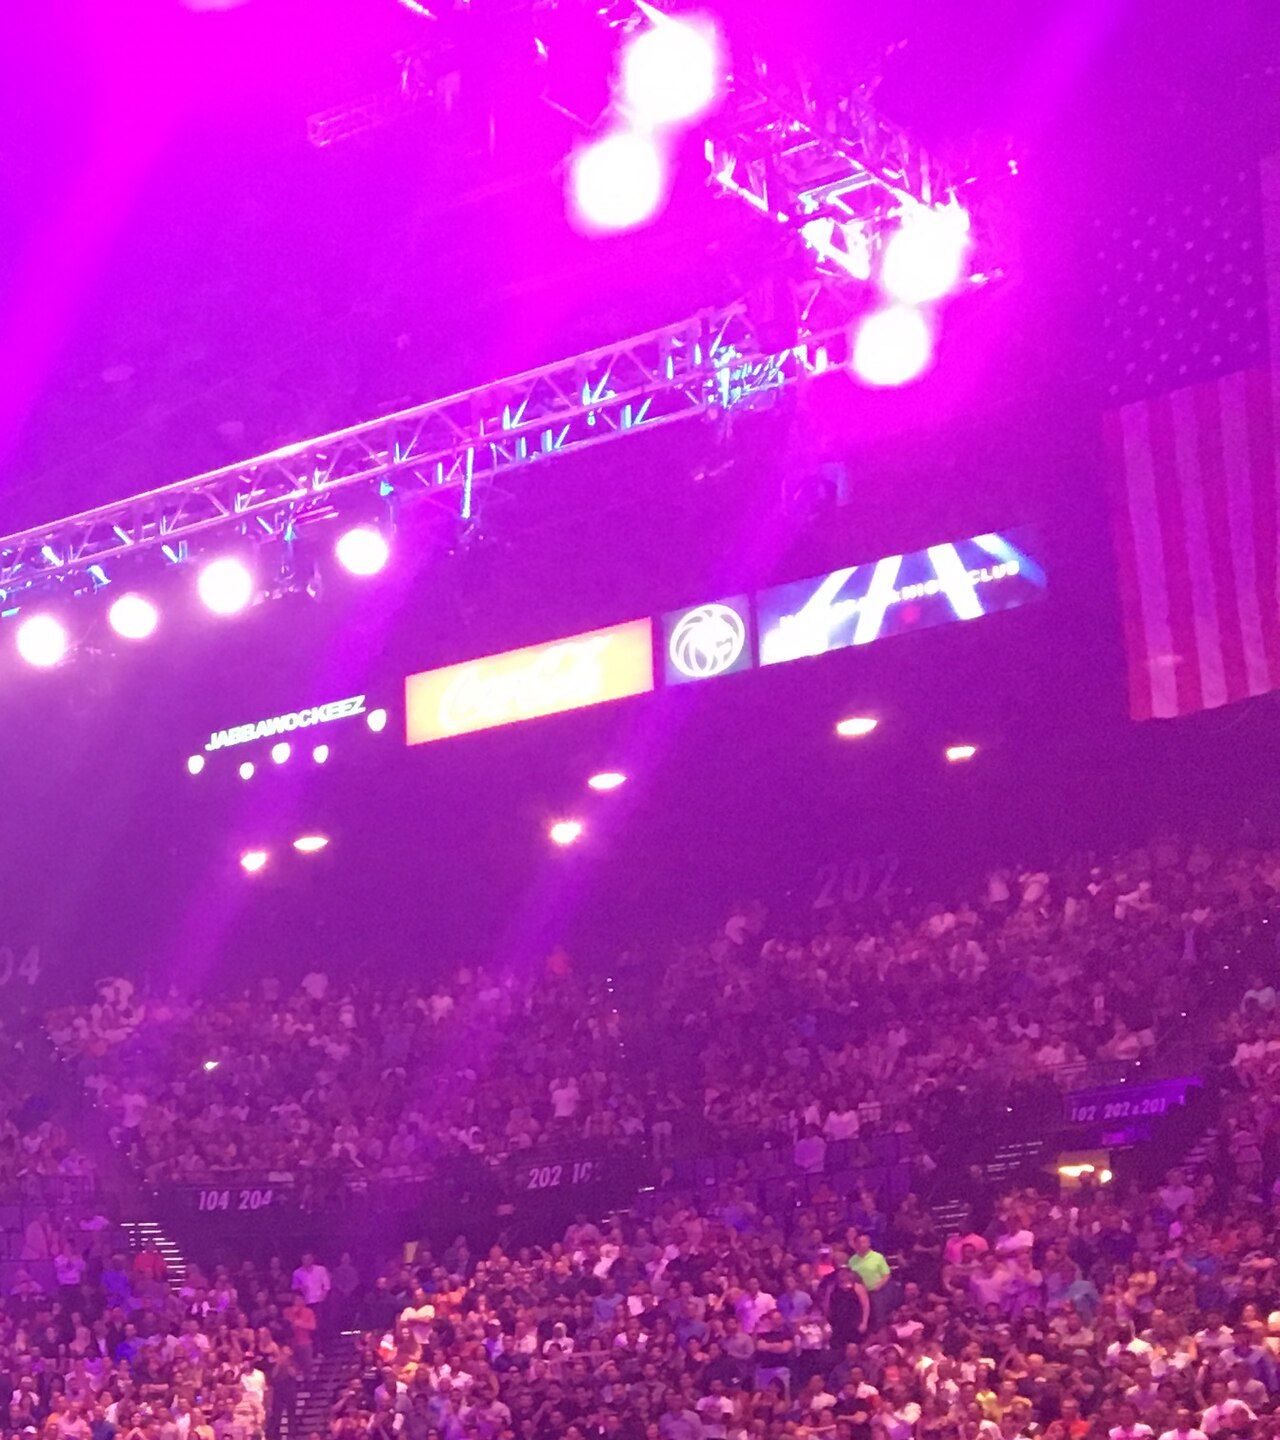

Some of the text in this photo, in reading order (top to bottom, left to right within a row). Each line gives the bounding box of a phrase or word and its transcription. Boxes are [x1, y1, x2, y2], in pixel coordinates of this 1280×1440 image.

[204, 694, 366, 751] JABBAWOCKEEZ
[1071, 1105, 1096, 1122] 102
[527, 1165, 563, 1190] 202
[198, 1189, 273, 1211] 104 204
